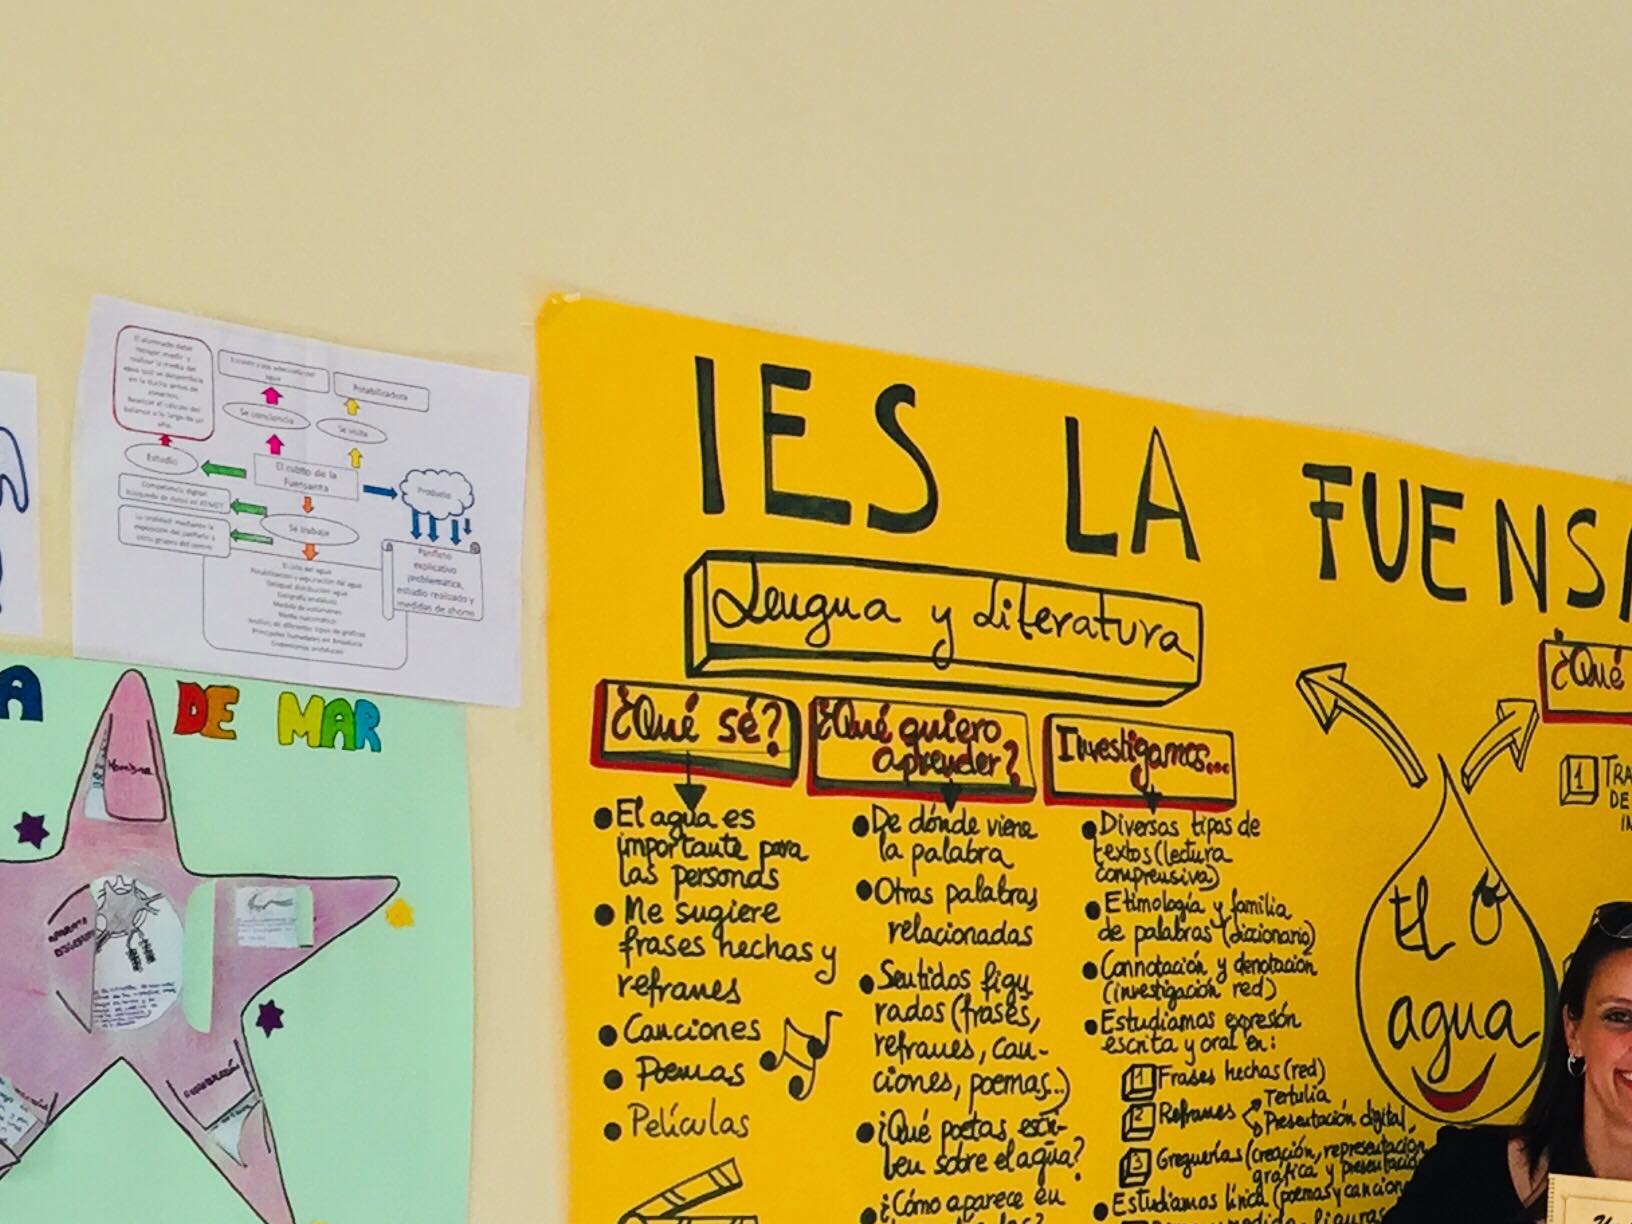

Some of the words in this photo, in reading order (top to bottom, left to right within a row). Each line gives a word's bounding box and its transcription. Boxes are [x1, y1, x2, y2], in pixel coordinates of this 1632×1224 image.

[695, 355, 939, 534] IES
[1064, 416, 1201, 563] LA
[712, 556, 901, 647] Lengua
[930, 603, 957, 670] y
[973, 577, 1195, 663] Literatura
[1551, 629, 1625, 695] ¿Qué
[173, 680, 240, 740] DE
[277, 691, 382, 752] MAR
[611, 684, 700, 742] ¿Qué
[717, 694, 782, 757] sé?
[816, 700, 893, 743] ¿Qué
[898, 708, 1002, 751] quiero
[872, 739, 1021, 788] aprender?
[616, 796, 645, 828] El
[650, 808, 718, 840] agua
[721, 808, 756, 830] es
[1609, 791, 1630, 809] DE
[872, 803, 901, 834] De
[908, 803, 981, 835] dónde
[986, 813, 1039, 840] viene
[1099, 809, 1180, 837] Diversos
[1191, 809, 1233, 843] tipos
[1237, 809, 1261, 838] de
[617, 832, 748, 866] importante
[759, 840, 810, 874] para
[878, 829, 903, 862] la
[911, 835, 1015, 877] palabra
[1092, 839, 1151, 866] textos
[619, 855, 659, 888] las
[671, 863, 780, 902] personas
[874, 876, 934, 905] Otras
[945, 873, 1039, 915] palabras
[625, 894, 664, 924] Me
[674, 899, 782, 939] sugiere
[1104, 889, 1206, 922] Etimología
[1231, 887, 1293, 927] familia
[887, 911, 1034, 947] relacionadas
[1098, 916, 1126, 943] de
[1133, 915, 1213, 958] palabras
[618, 924, 706, 969] frases
[719, 933, 813, 962] hechas
[814, 945, 837, 985] y
[877, 957, 971, 991] Sentidos
[1101, 948, 1208, 980] Connotación
[617, 965, 741, 1009] refranes
[1232, 976, 1278, 1001] red)
[623, 1012, 762, 1044] Canciones
[874, 993, 946, 1026] rados
[1100, 1005, 1216, 1035] Estudiamos
[873, 1029, 987, 1066] refranes,
[1101, 1033, 1178, 1055] escrita
[1199, 1030, 1238, 1052] oral
[1387, 994, 1541, 1085] agua
[635, 1055, 745, 1092] Poemas
[872, 1065, 961, 1102] ciones,
[1157, 1064, 1217, 1090] Frases
[1224, 1058, 1281, 1082] hechas
[1283, 1056, 1327, 1085] (red)
[627, 1097, 750, 1140] Películas
[941, 1111, 1008, 1152] poetas
[1158, 1098, 1237, 1130] Refranes
[933, 1141, 989, 1176] sobre
[1155, 1140, 1244, 1179] Greguerías
[946, 1190, 1025, 1223] aparece
[1034, 1185, 1067, 1207] en
[1112, 1186, 1219, 1218] Estudiamos
